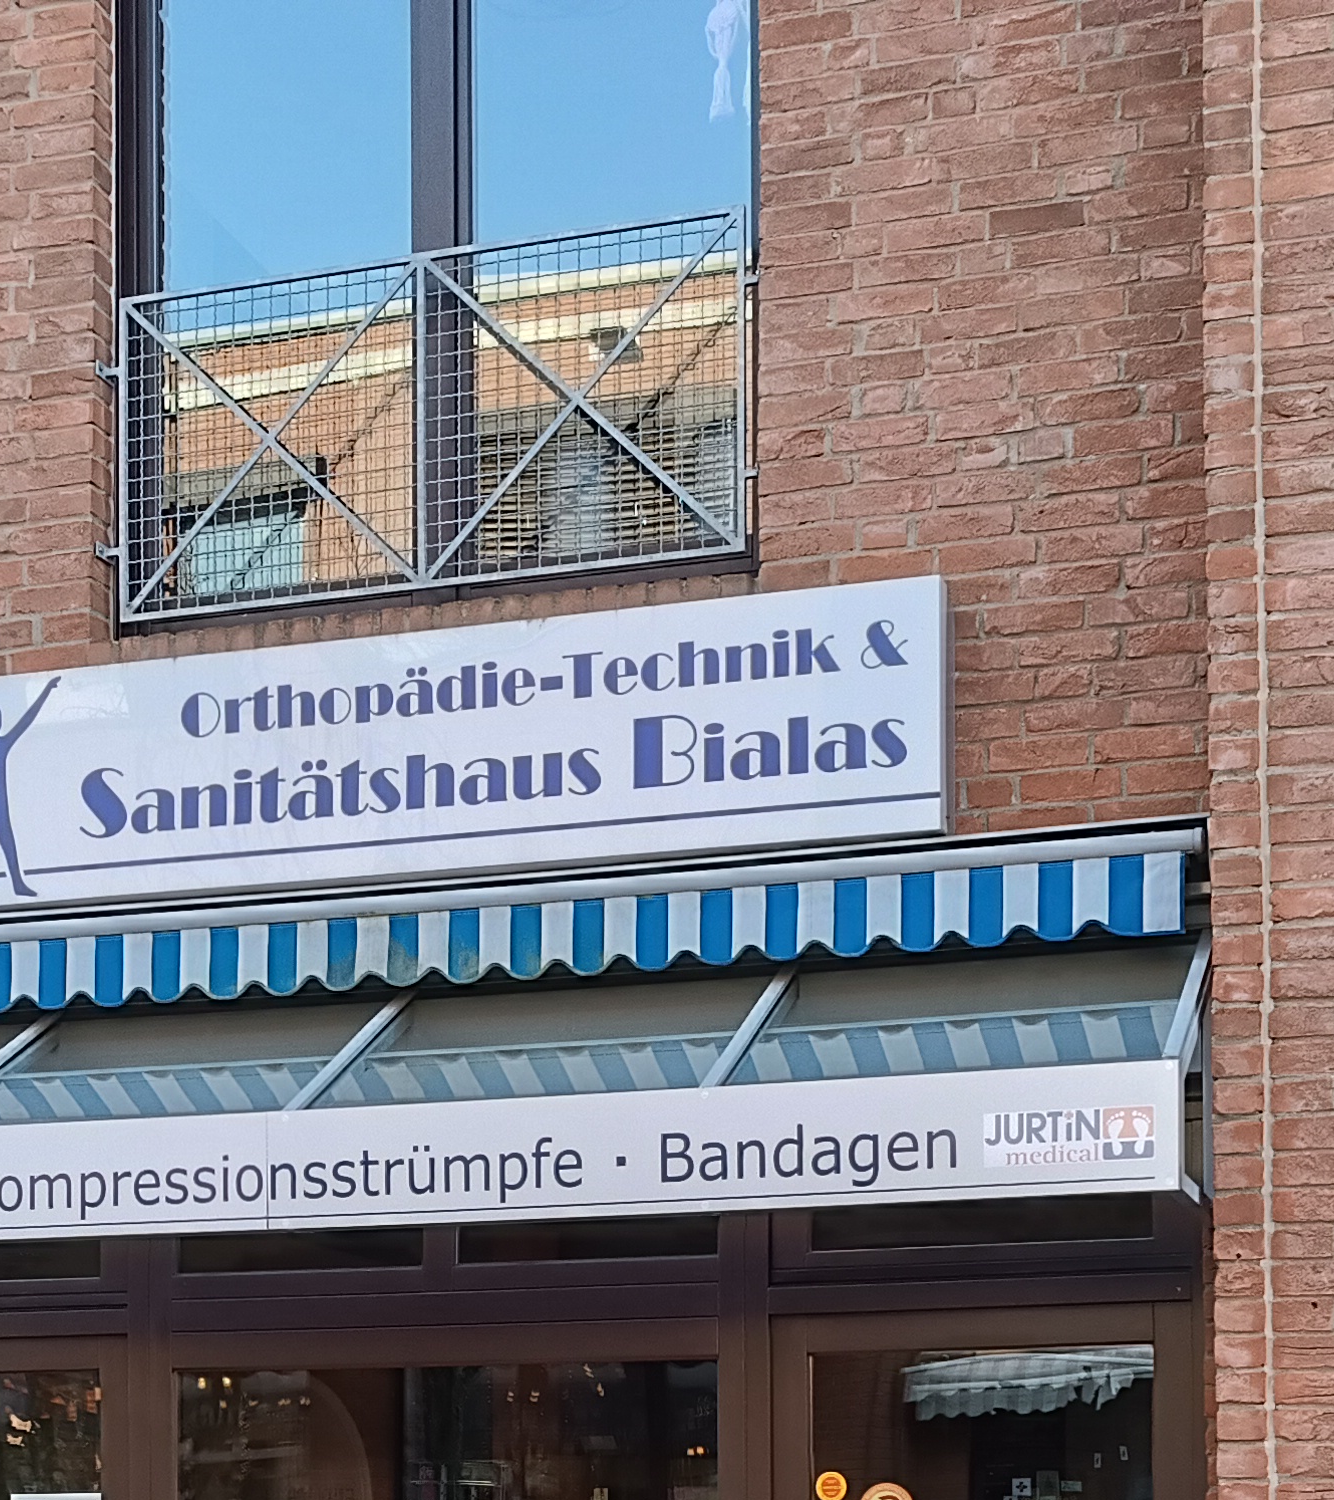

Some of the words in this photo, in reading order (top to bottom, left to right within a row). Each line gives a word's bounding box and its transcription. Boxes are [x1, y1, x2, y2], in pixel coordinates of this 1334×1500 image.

[179, 628, 840, 738] Orthopädie-Technik
[860, 619, 908, 670] &
[80, 746, 602, 838] Sanitätshaus
[632, 713, 907, 790] Bialas
[659, 1124, 959, 1187] Bandagen
[1005, 1143, 1100, 1167] medical
